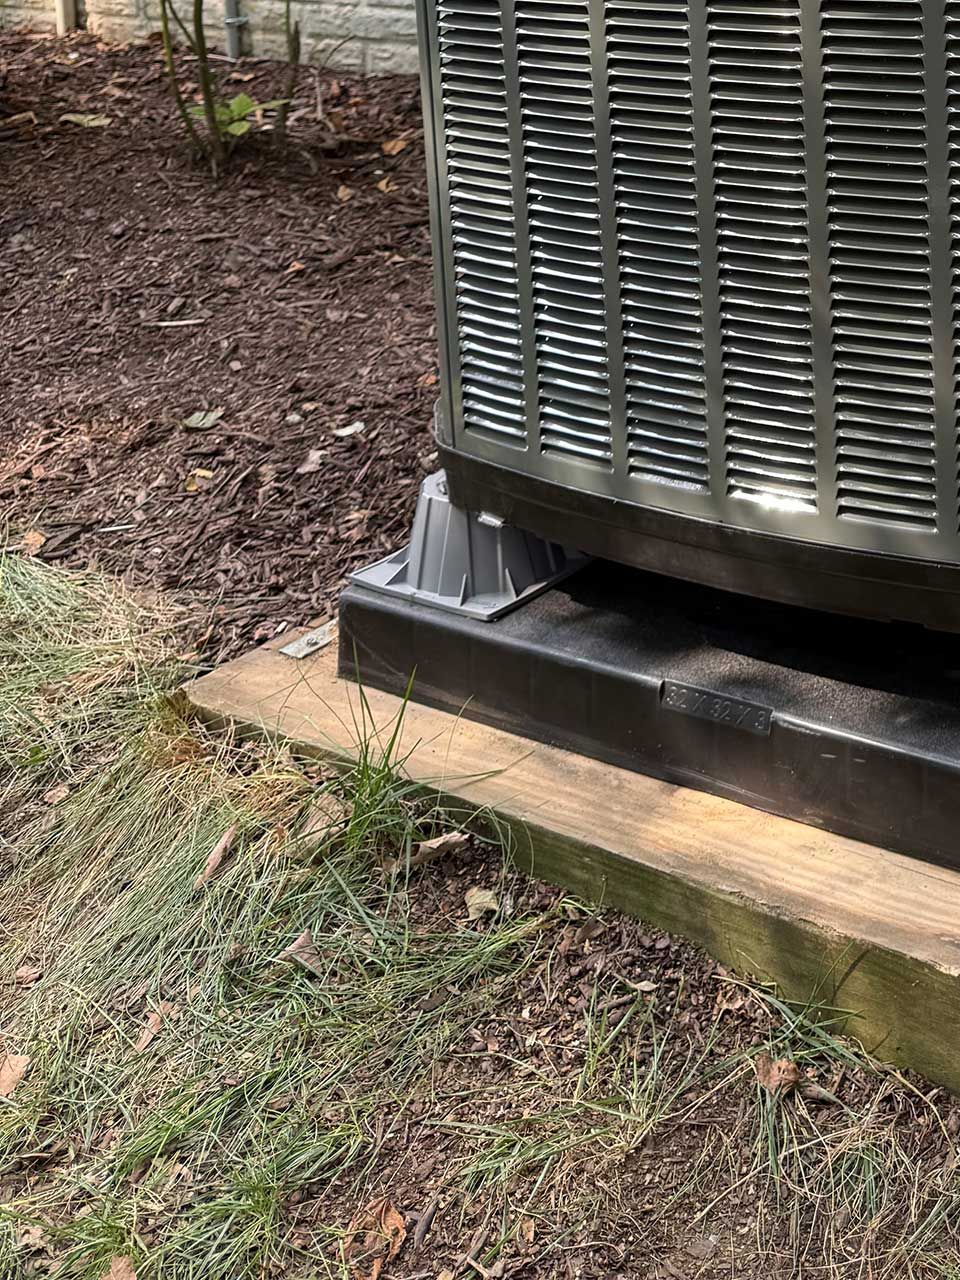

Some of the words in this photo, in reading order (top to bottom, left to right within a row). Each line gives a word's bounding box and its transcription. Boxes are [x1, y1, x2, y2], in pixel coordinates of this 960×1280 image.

[666, 685, 688, 709] 32
[709, 697, 732, 721] 32
[754, 710, 767, 730] 3
